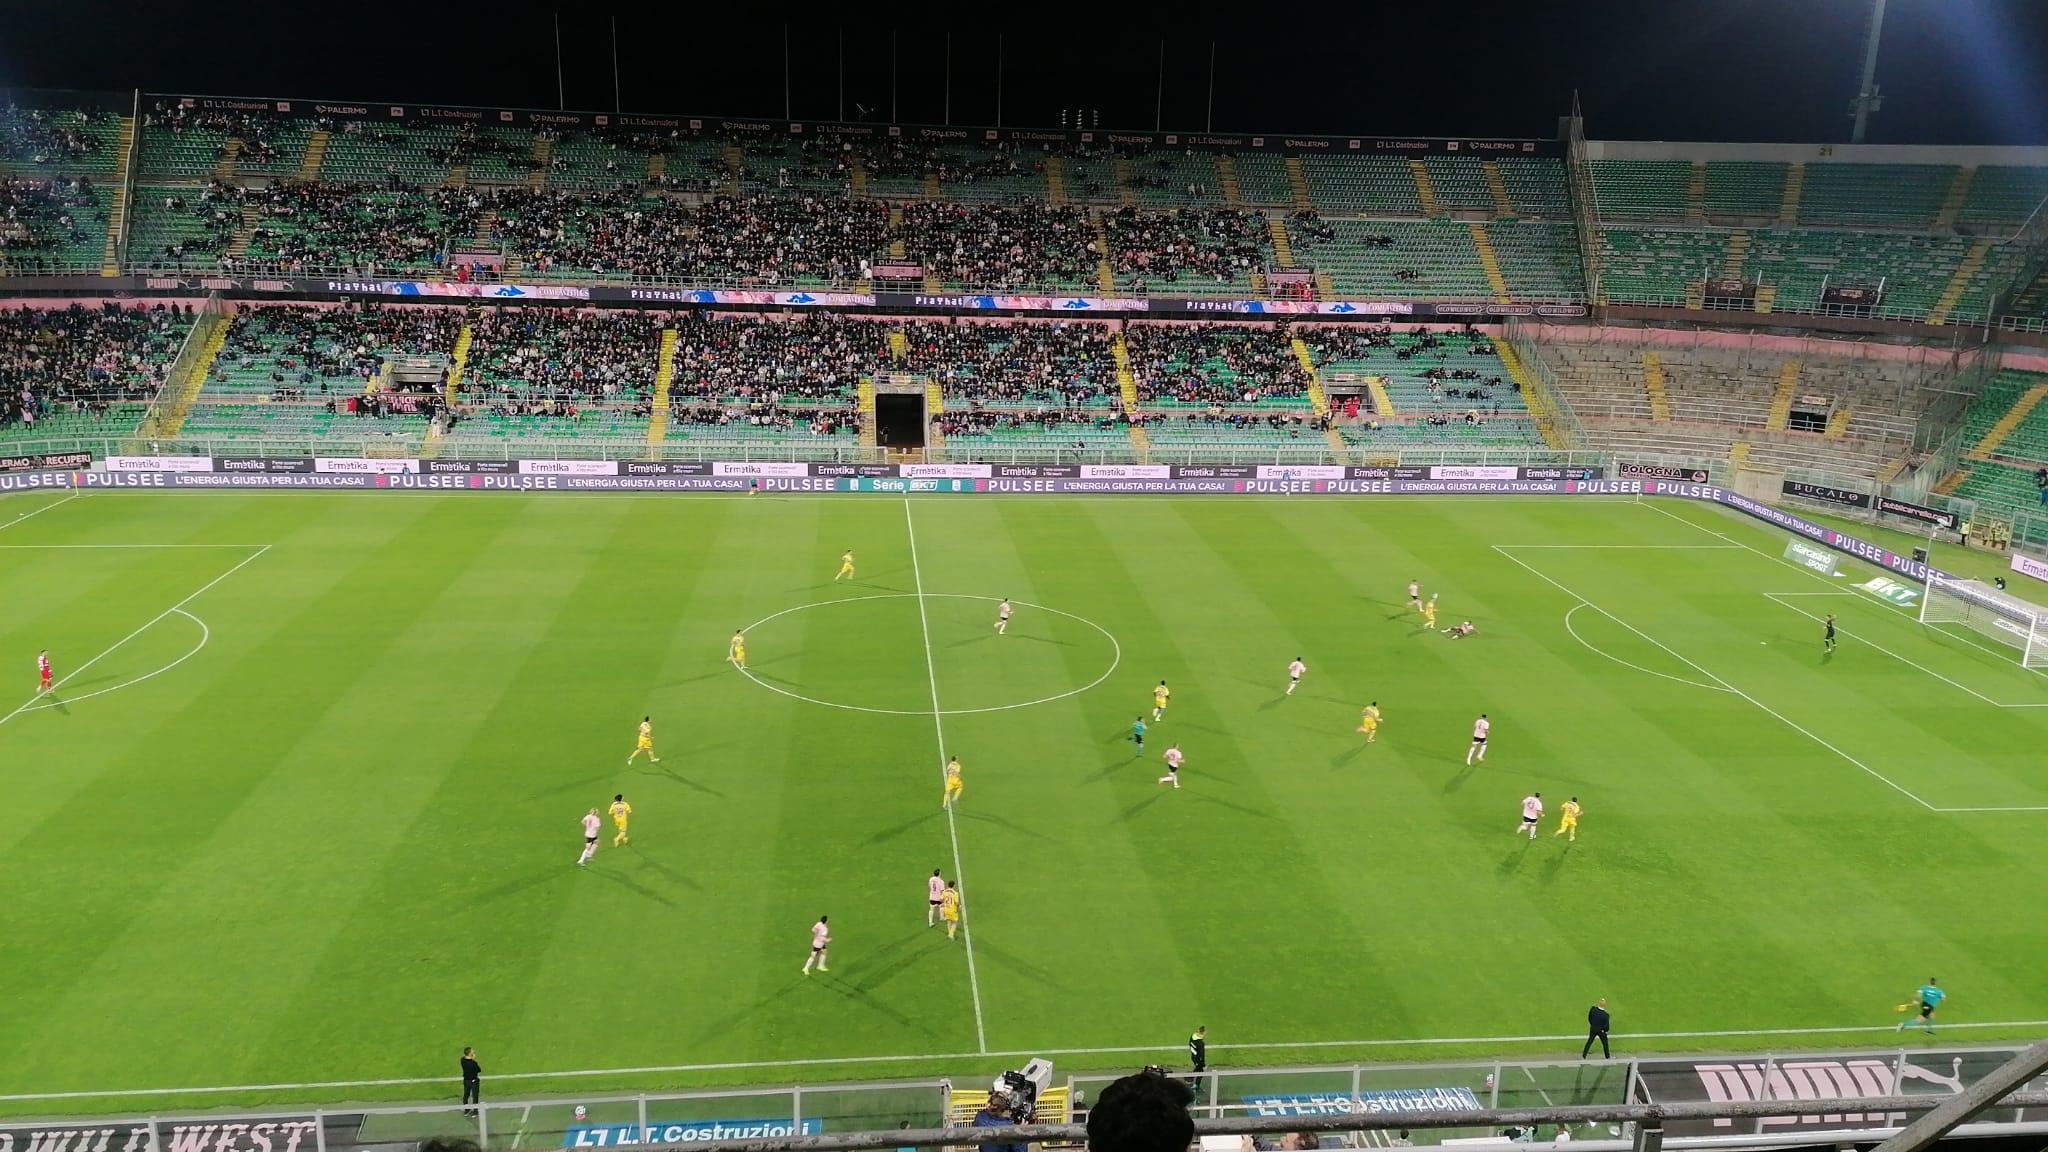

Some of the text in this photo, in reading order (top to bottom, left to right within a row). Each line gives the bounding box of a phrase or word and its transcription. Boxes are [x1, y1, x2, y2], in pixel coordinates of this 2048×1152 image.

[327, 106, 368, 115] PALERMO
[541, 115, 581, 124] PALERMO
[733, 122, 771, 131] PALERMO
[930, 130, 967, 138] PALERMO
[1294, 140, 1329, 148] PALERMO
[1479, 142, 1515, 150] PALERMO
[146, 278, 178, 289] PUMA
[201, 279, 232, 290] PUMA
[253, 280, 284, 291] PUMA
[46, 455, 91, 465] RECUPERI
[1622, 464, 1682, 477] BOLOGNA
[87, 473, 165, 487] PULSEE
[231, 476, 269, 486] GIUSTA
[271, 476, 292, 486] PER
[294, 476, 307, 486] LA
[309, 476, 331, 486] TUA
[333, 476, 365, 486] CASA!
[390, 475, 465, 488] PULSEE
[484, 476, 558, 489] PULSEE
[620, 479, 655, 488] GIUSTA
[657, 479, 675, 488] PER
[678, 479, 691, 488] LA
[692, 479, 713, 488] TUA
[714, 479, 743, 488] CASA!
[766, 478, 835, 490] PULSEE
[872, 479, 937, 490] Serie BKT
[988, 480, 1055, 492] PULSEE
[1112, 481, 1143, 491] GIUSTA
[1145, 481, 1163, 491] PER
[1165, 481, 1177, 491] LA
[1178, 481, 1196, 491] TUA
[1198, 481, 1225, 491] CASA!
[1246, 481, 1310, 492] PULSEE
[1327, 481, 1391, 492] PULSEE
[1447, 482, 1477, 491] GIUSTA
[1480, 482, 1496, 491] PER
[1498, 482, 1509, 491] LA
[1511, 482, 1528, 491] TUA
[1530, 482, 1557, 491] CASA!
[1577, 481, 1640, 493] PULSEE
[1657, 482, 1721, 501] PULSEE
[1794, 483, 1858, 500] BUCALO
[1754, 505, 1773, 518] GIUSTA
[1773, 511, 1784, 522] PER
[1784, 516, 1792, 526] LA
[1792, 519, 1804, 531] TUA
[1804, 523, 1823, 537] CASA!
[1835, 534, 1881, 563] PULSEE
[1804, 558, 1828, 573] SPORT
[1865, 576, 1918, 602] BKT
